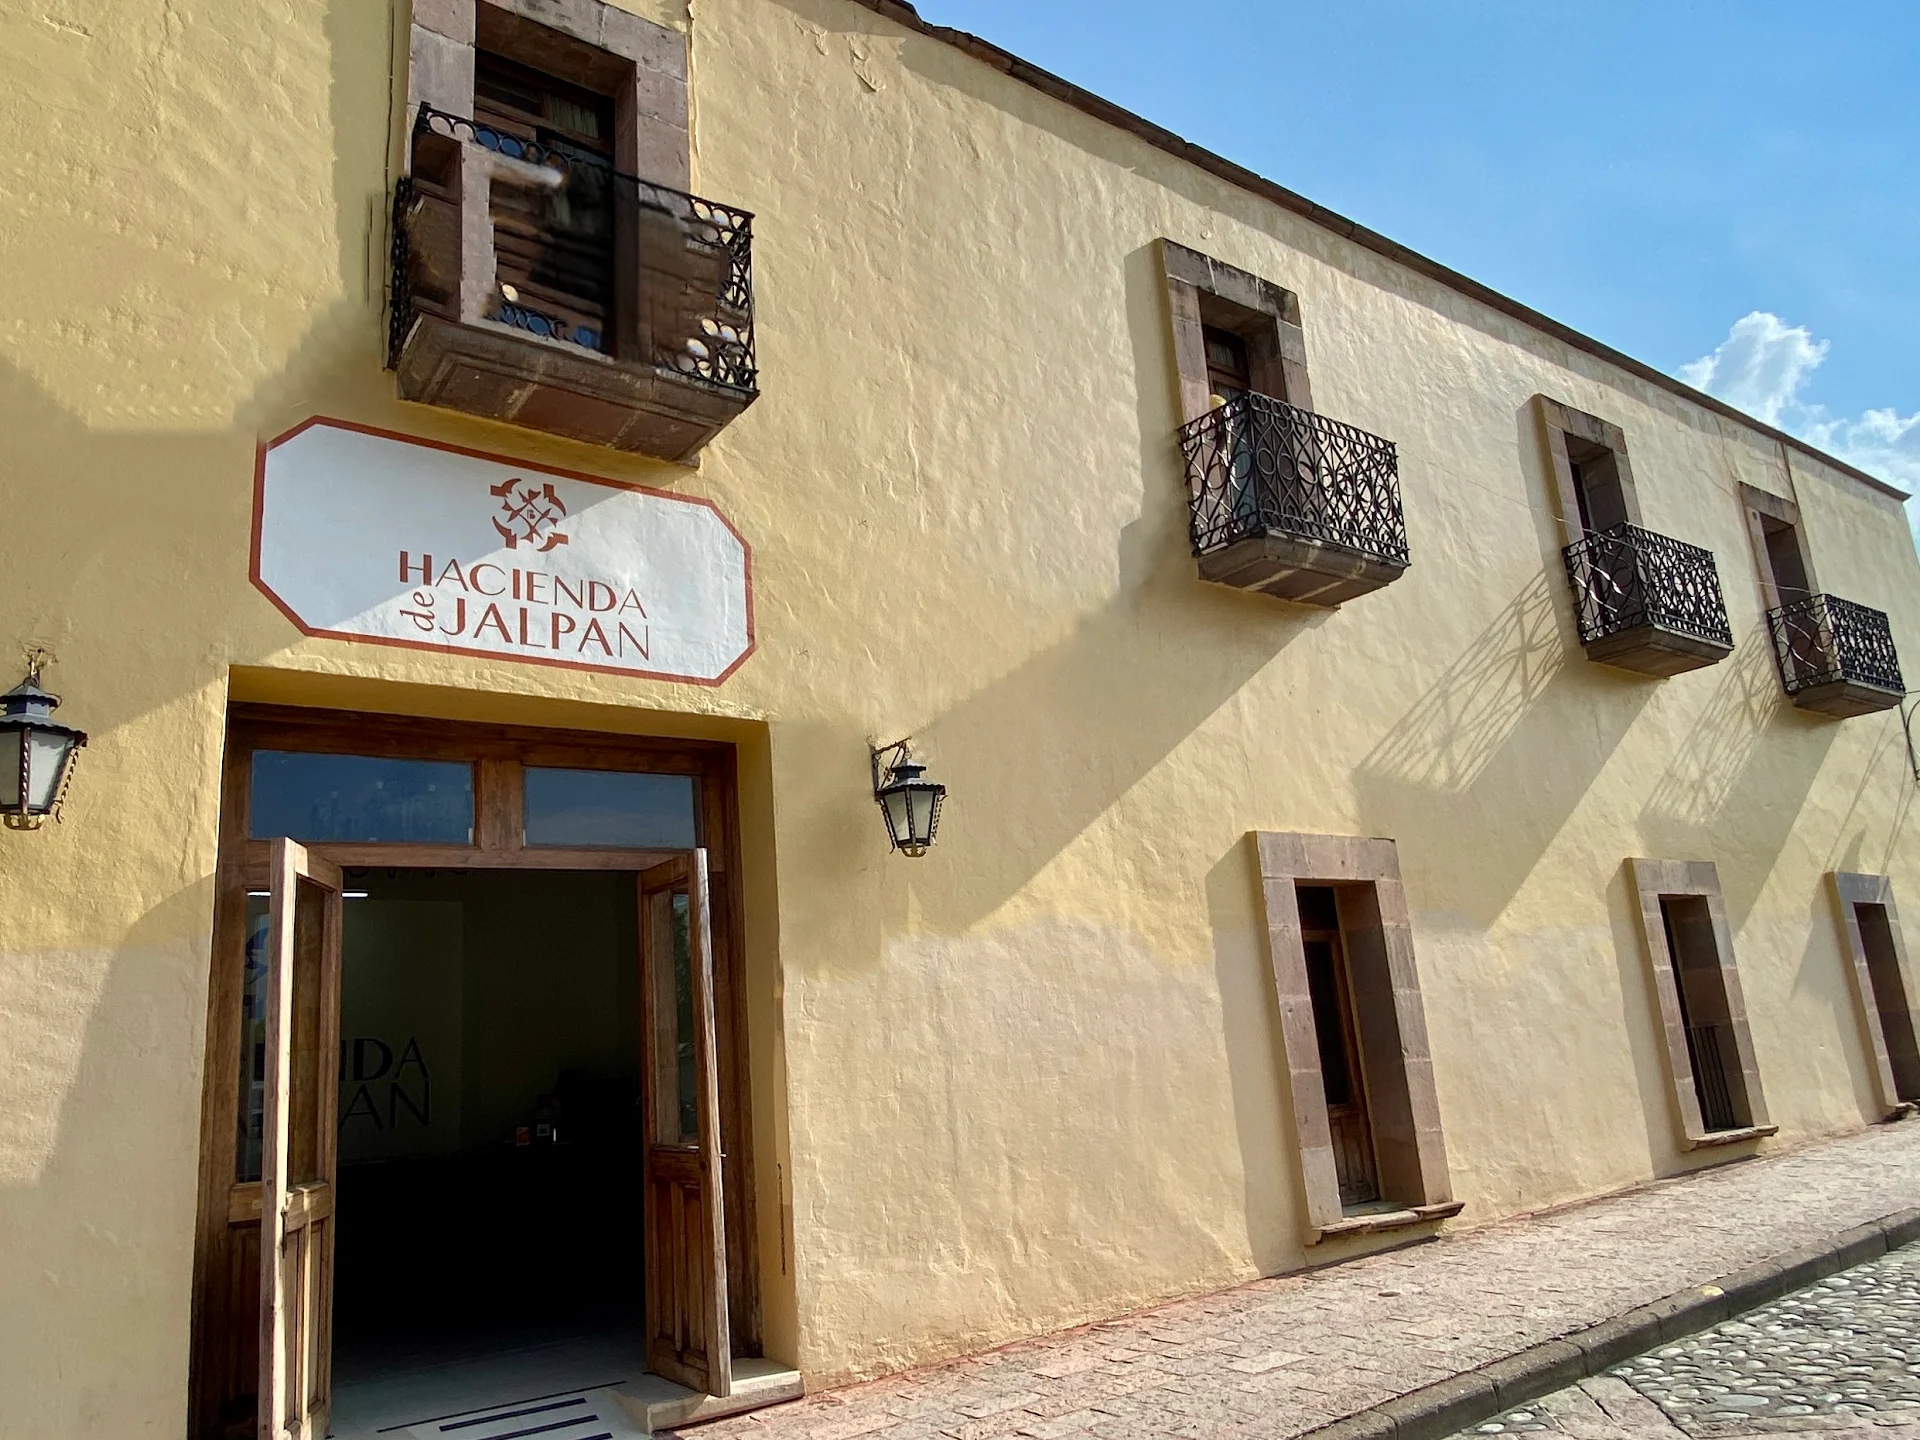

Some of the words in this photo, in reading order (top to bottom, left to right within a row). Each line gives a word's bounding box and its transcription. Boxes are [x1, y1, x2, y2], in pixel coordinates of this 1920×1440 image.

[400, 551, 647, 619] HACIENDA
[400, 591, 435, 632] de
[439, 598, 649, 661] JALPAN
